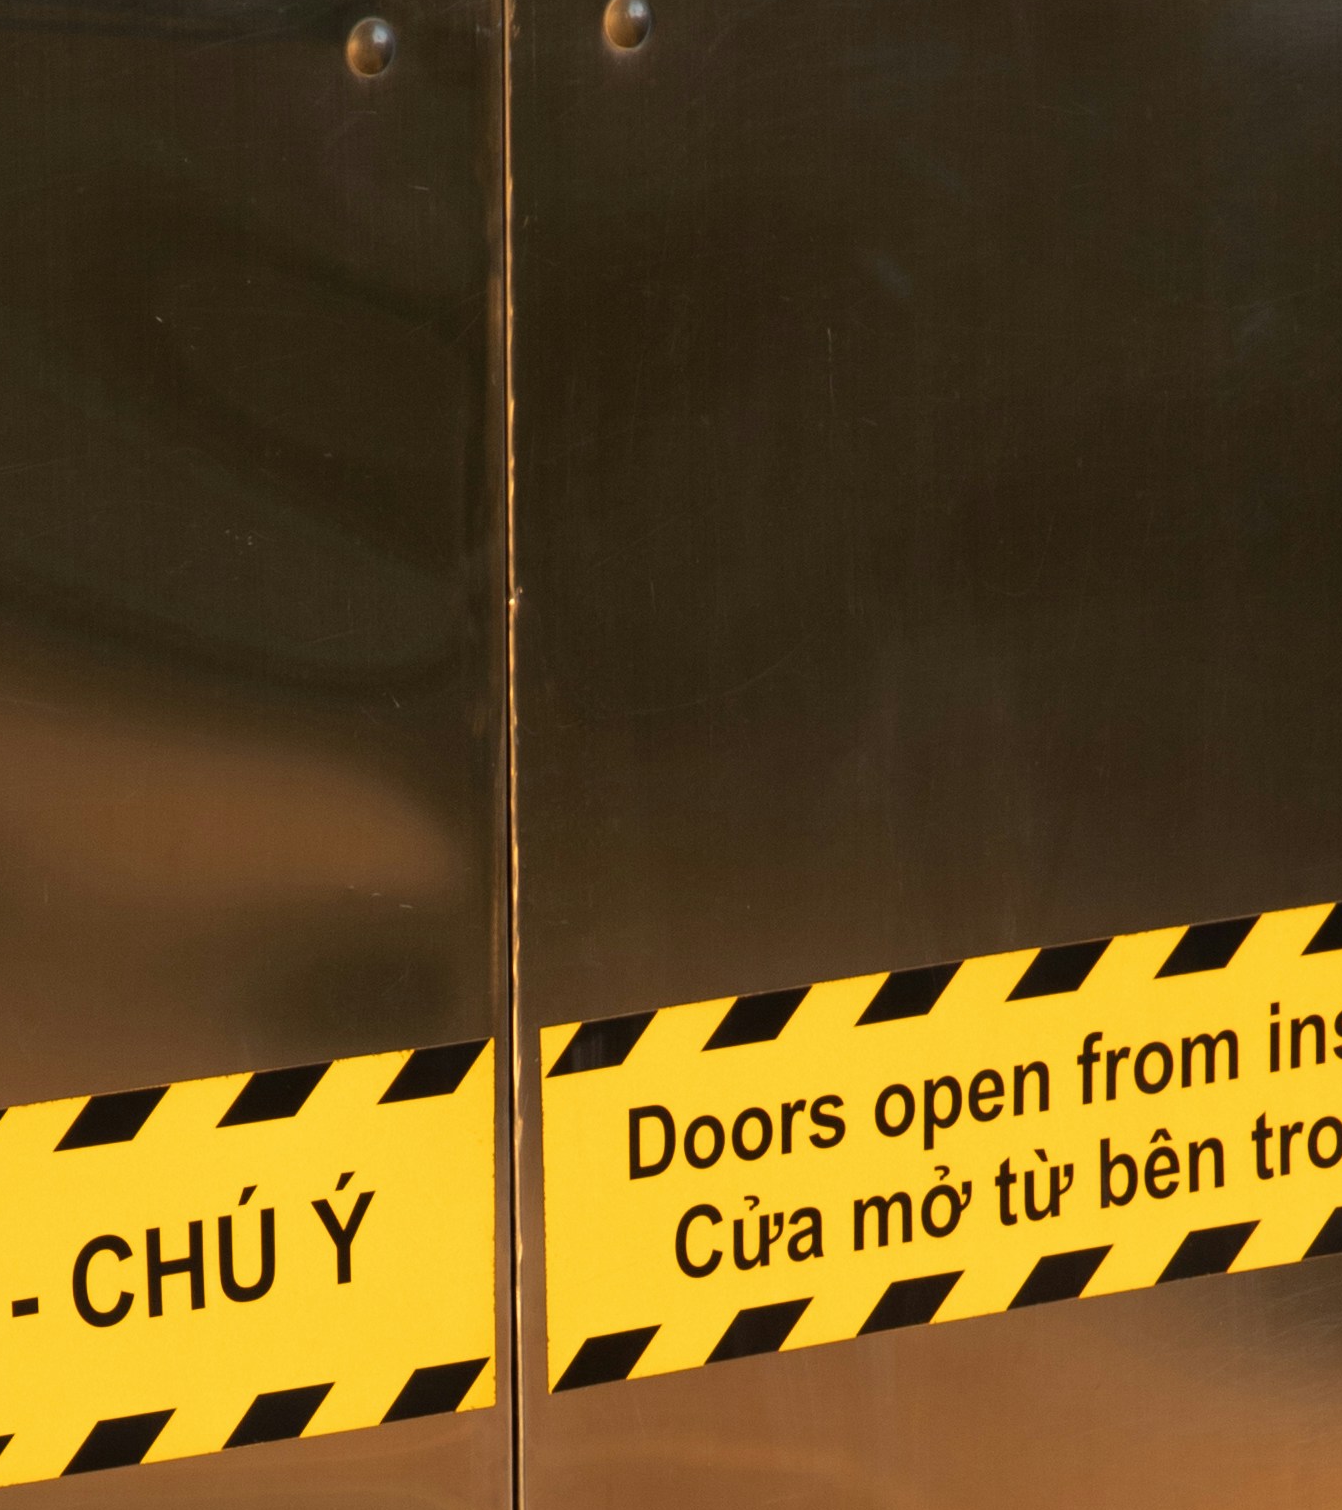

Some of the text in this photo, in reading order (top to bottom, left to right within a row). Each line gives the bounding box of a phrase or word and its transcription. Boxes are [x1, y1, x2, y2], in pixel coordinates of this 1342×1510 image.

[628, 1094, 846, 1181] Doors
[874, 1060, 1050, 1151] open
[1076, 1029, 1239, 1105] from
[11, 1296, 39, 1318] -
[72, 1185, 276, 1328] CHÚ
[311, 1171, 375, 1285] Ý
[675, 1195, 824, 1279] Cửa
[853, 1165, 973, 1252] mở
[994, 1148, 1074, 1227] từ
[1099, 1128, 1225, 1209] bên
